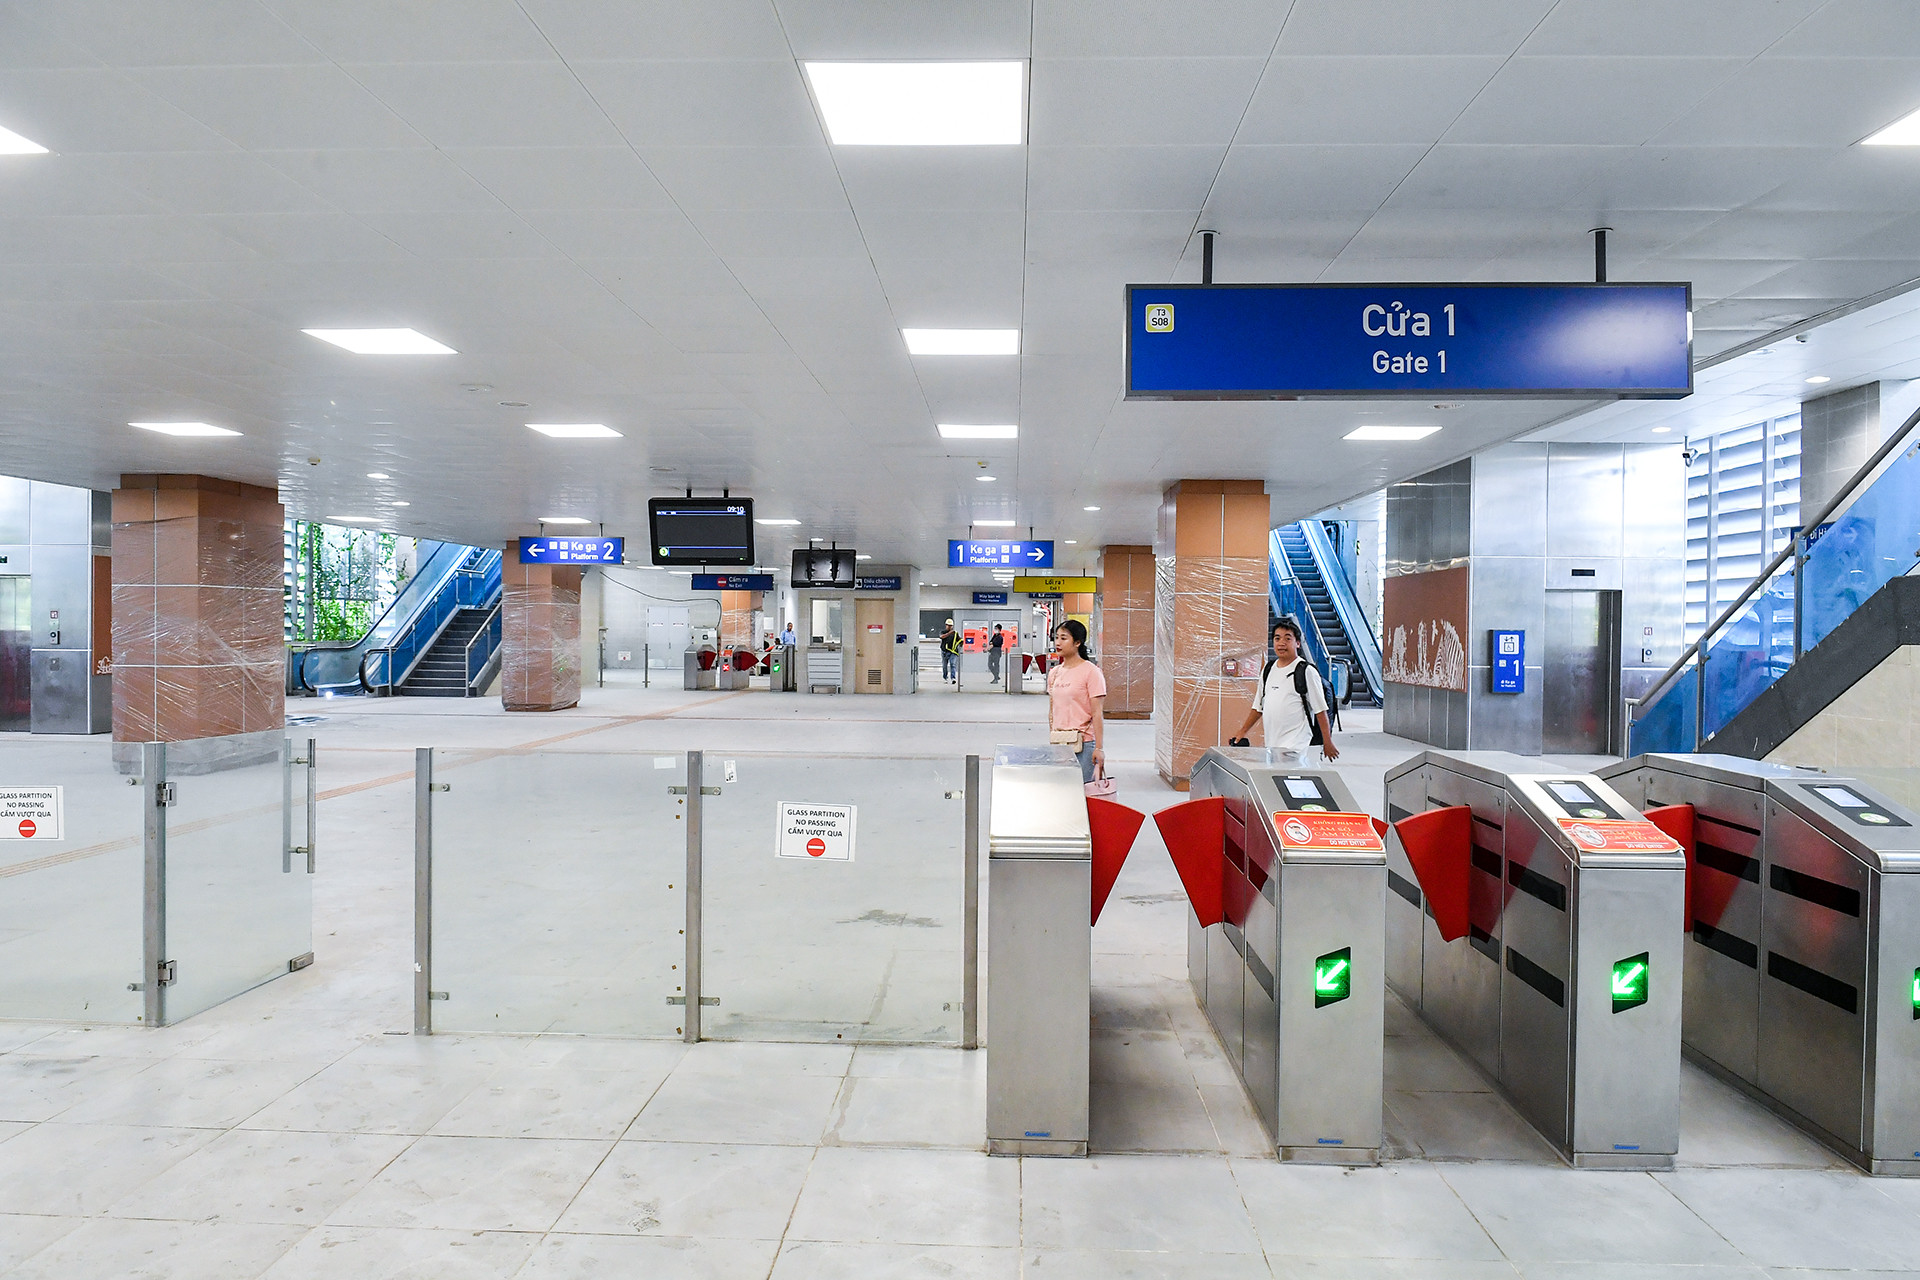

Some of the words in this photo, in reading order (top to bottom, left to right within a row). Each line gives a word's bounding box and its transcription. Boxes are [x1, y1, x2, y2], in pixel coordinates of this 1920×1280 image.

[1156, 308, 1166, 316] T3
[1151, 317, 1169, 326] S08
[1362, 301, 1430, 336] Cửa
[1443, 304, 1455, 336] 1
[1372, 350, 1429, 374] Gate
[1437, 350, 1446, 373] 1
[570, 541, 583, 551] Ke
[585, 543, 597, 553] ga
[602, 541, 615, 560] 2
[970, 544, 983, 554] Ke
[985, 546, 997, 556] ga
[956, 544, 964, 563] 1
[969, 556, 998, 564] Platform
[1513, 659, 1519, 677] 1
[809, 810, 846, 818] PARTITION
[807, 820, 836, 828] PASSING
[787, 826, 804, 835] CẤM
[805, 829, 826, 837] VƯỢT
